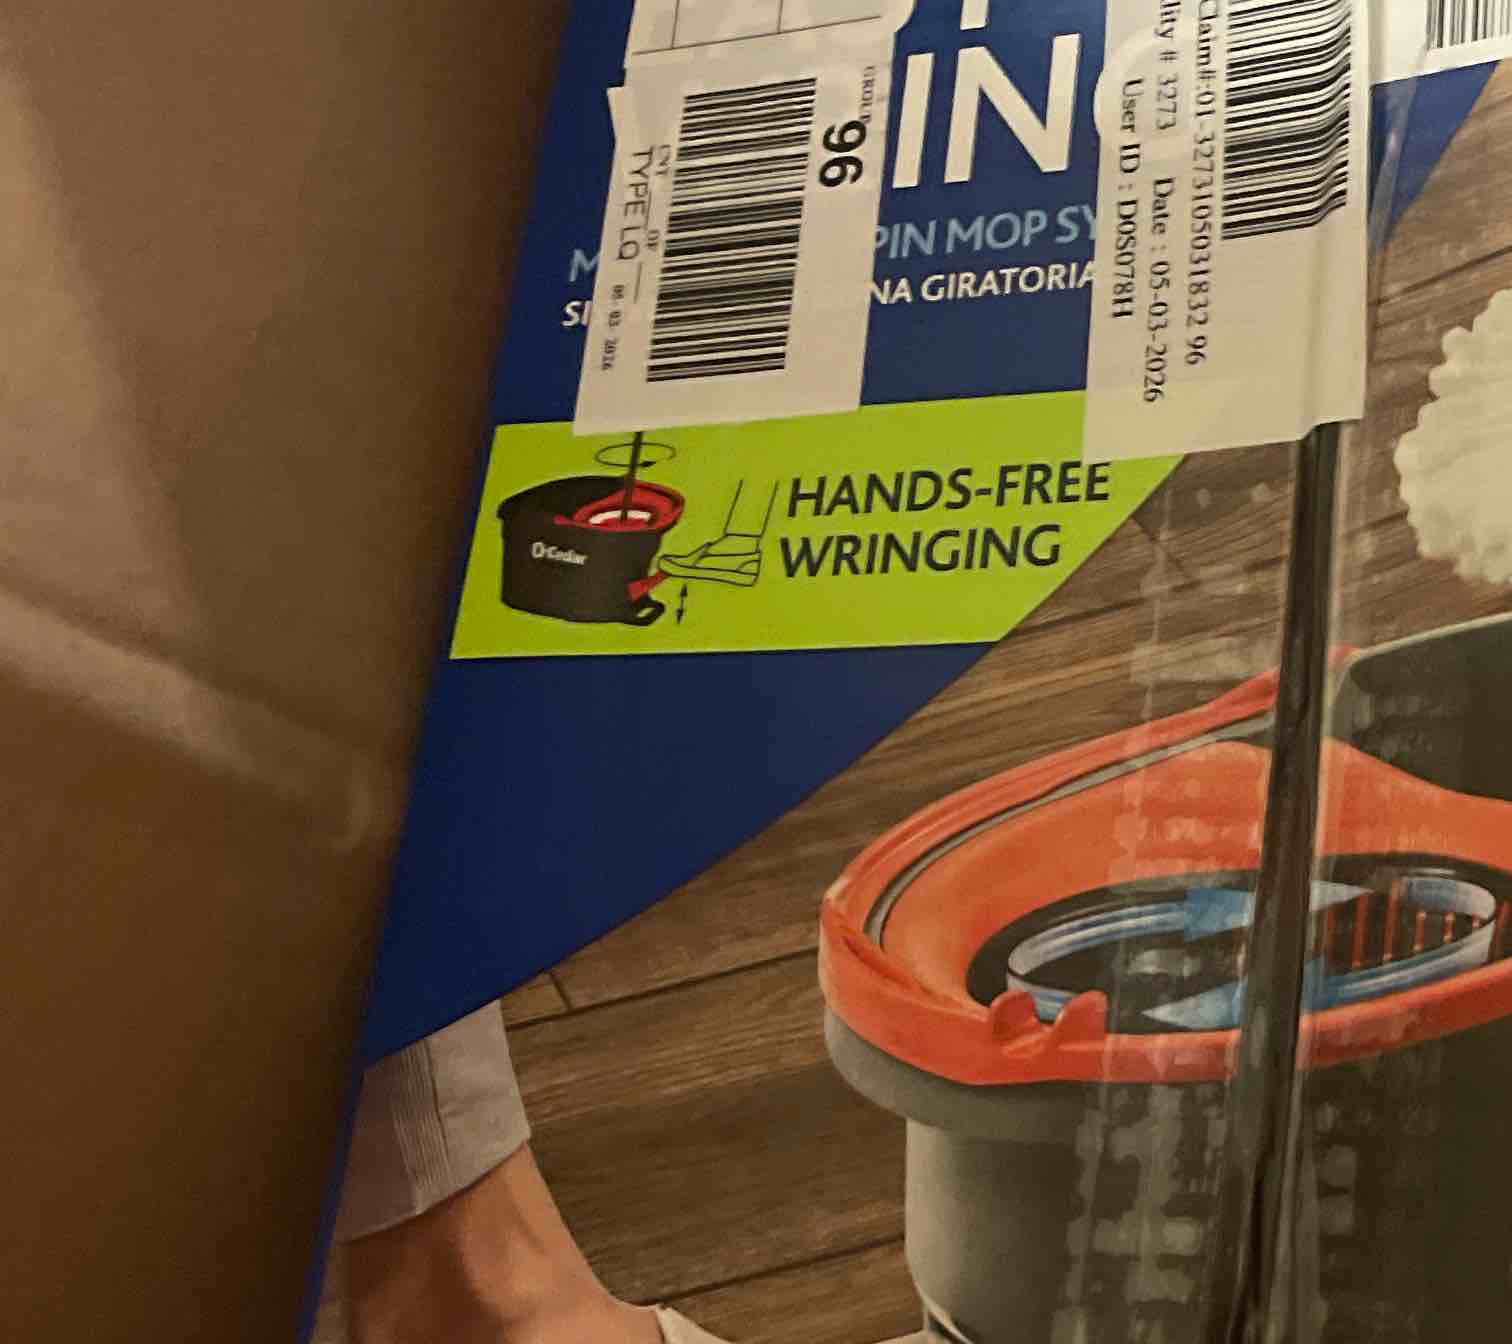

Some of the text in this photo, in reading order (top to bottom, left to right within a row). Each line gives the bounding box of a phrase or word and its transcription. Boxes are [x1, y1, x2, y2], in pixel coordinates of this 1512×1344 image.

[1158, 49, 1178, 64] #
[1120, 79, 1144, 134] User
[1155, 73, 1178, 132] 3273
[818, 119, 867, 188] 96
[1118, 143, 1142, 176] ID
[617, 145, 654, 261] TYPE LQ
[1150, 177, 1175, 236] Date
[944, 209, 1049, 255] MOP
[1143, 260, 1170, 404] 05-03-2026
[1185, 334, 1207, 367] 96
[786, 459, 1112, 518] HANDS-FREE
[780, 523, 1062, 579] WRINGING
